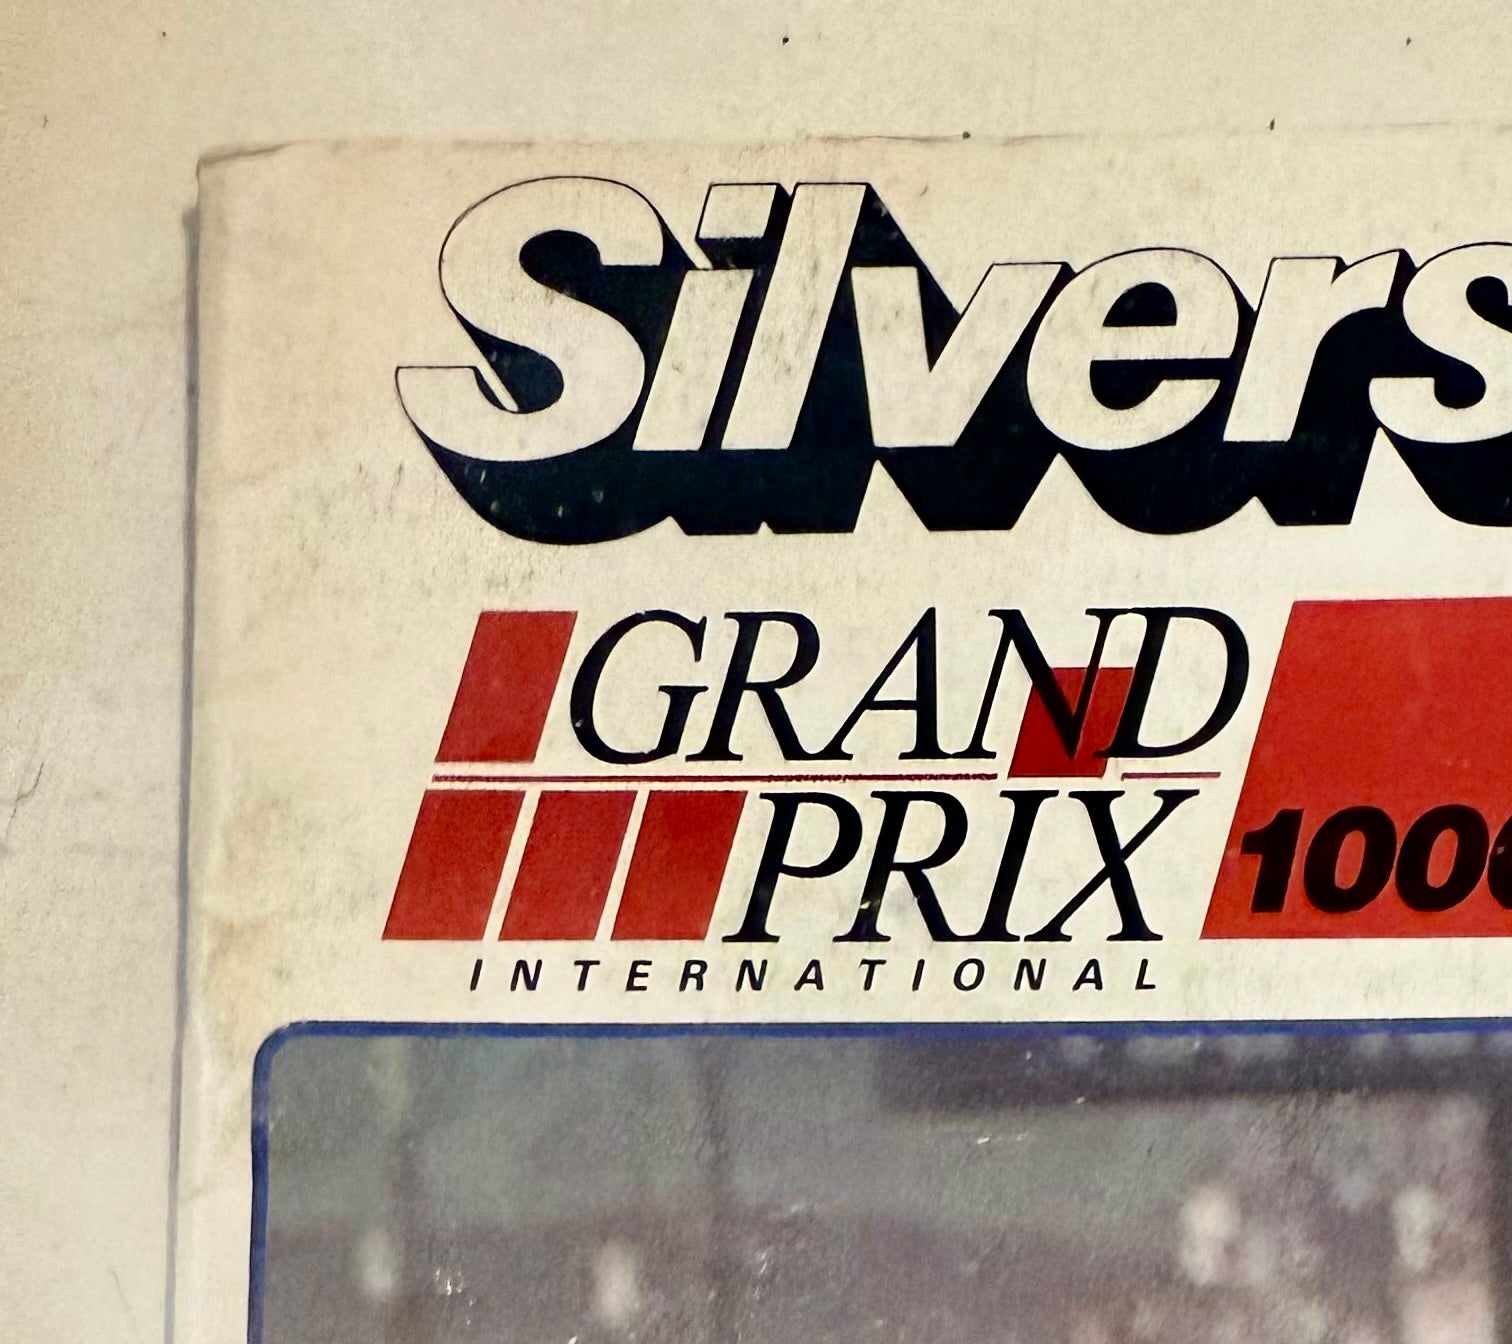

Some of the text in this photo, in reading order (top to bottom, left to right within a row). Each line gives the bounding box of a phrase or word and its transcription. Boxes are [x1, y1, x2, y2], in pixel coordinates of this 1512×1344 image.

[568, 607, 1251, 766] GRAND
[720, 788, 1200, 944] PRIX
[469, 958, 1157, 993] INTERNATIONAL
